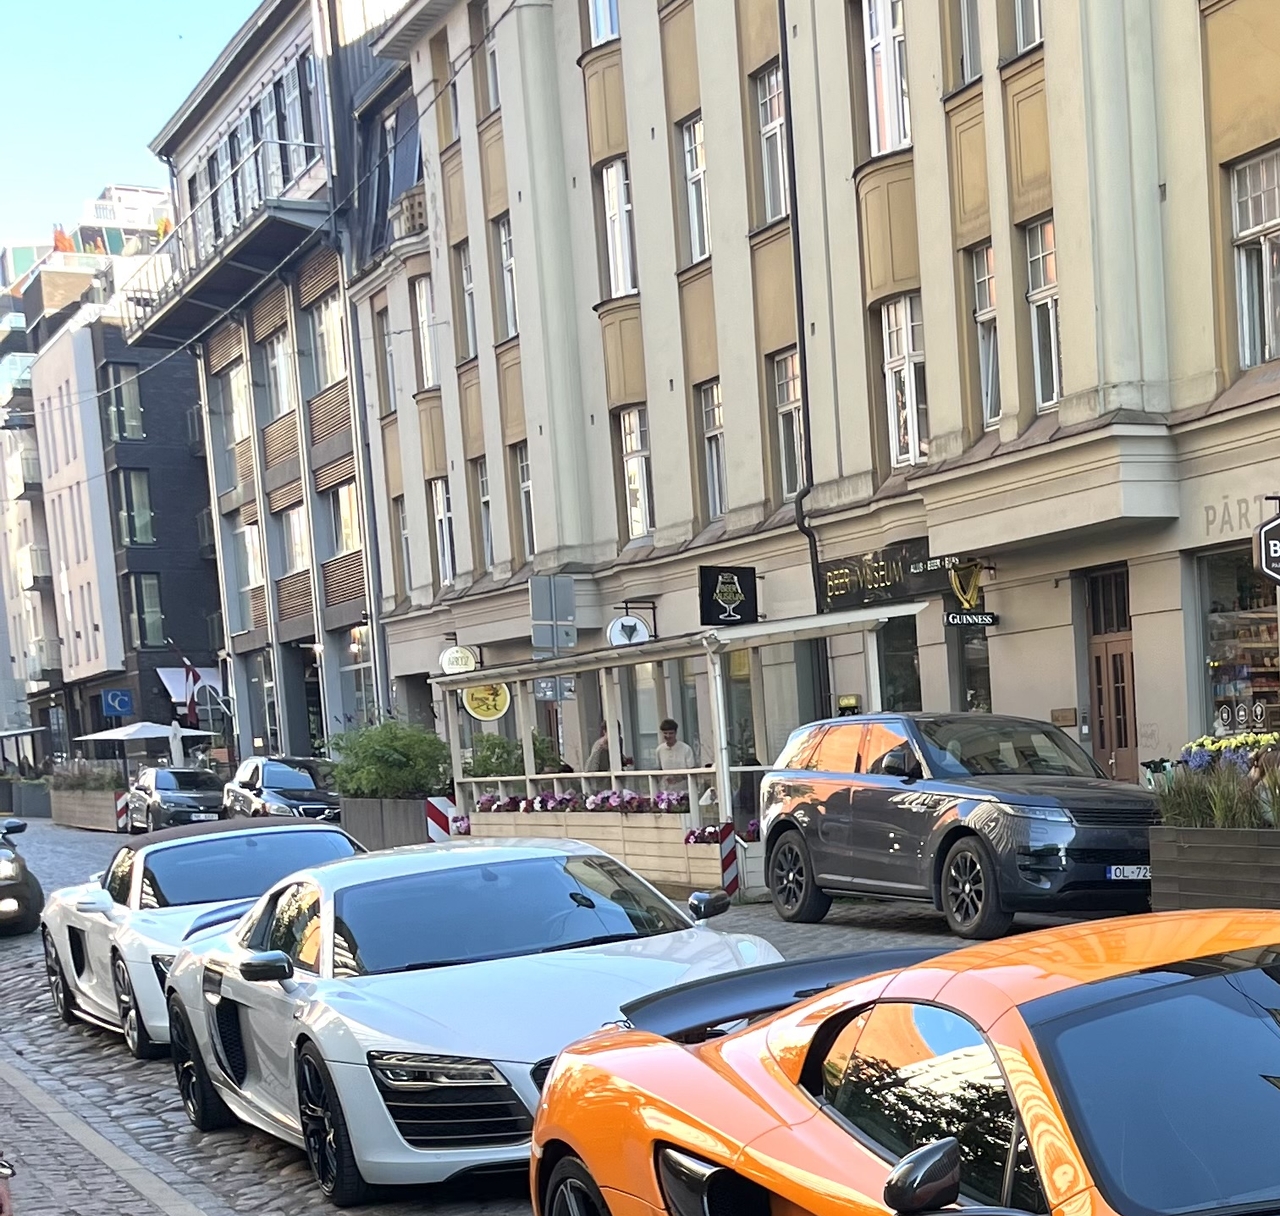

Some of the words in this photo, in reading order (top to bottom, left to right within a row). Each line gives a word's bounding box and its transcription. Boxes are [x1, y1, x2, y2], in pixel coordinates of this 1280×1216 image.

[827, 569, 850, 596] BEER
[855, 560, 904, 589] MUSEUM
[948, 613, 993, 625] GUINNESS
